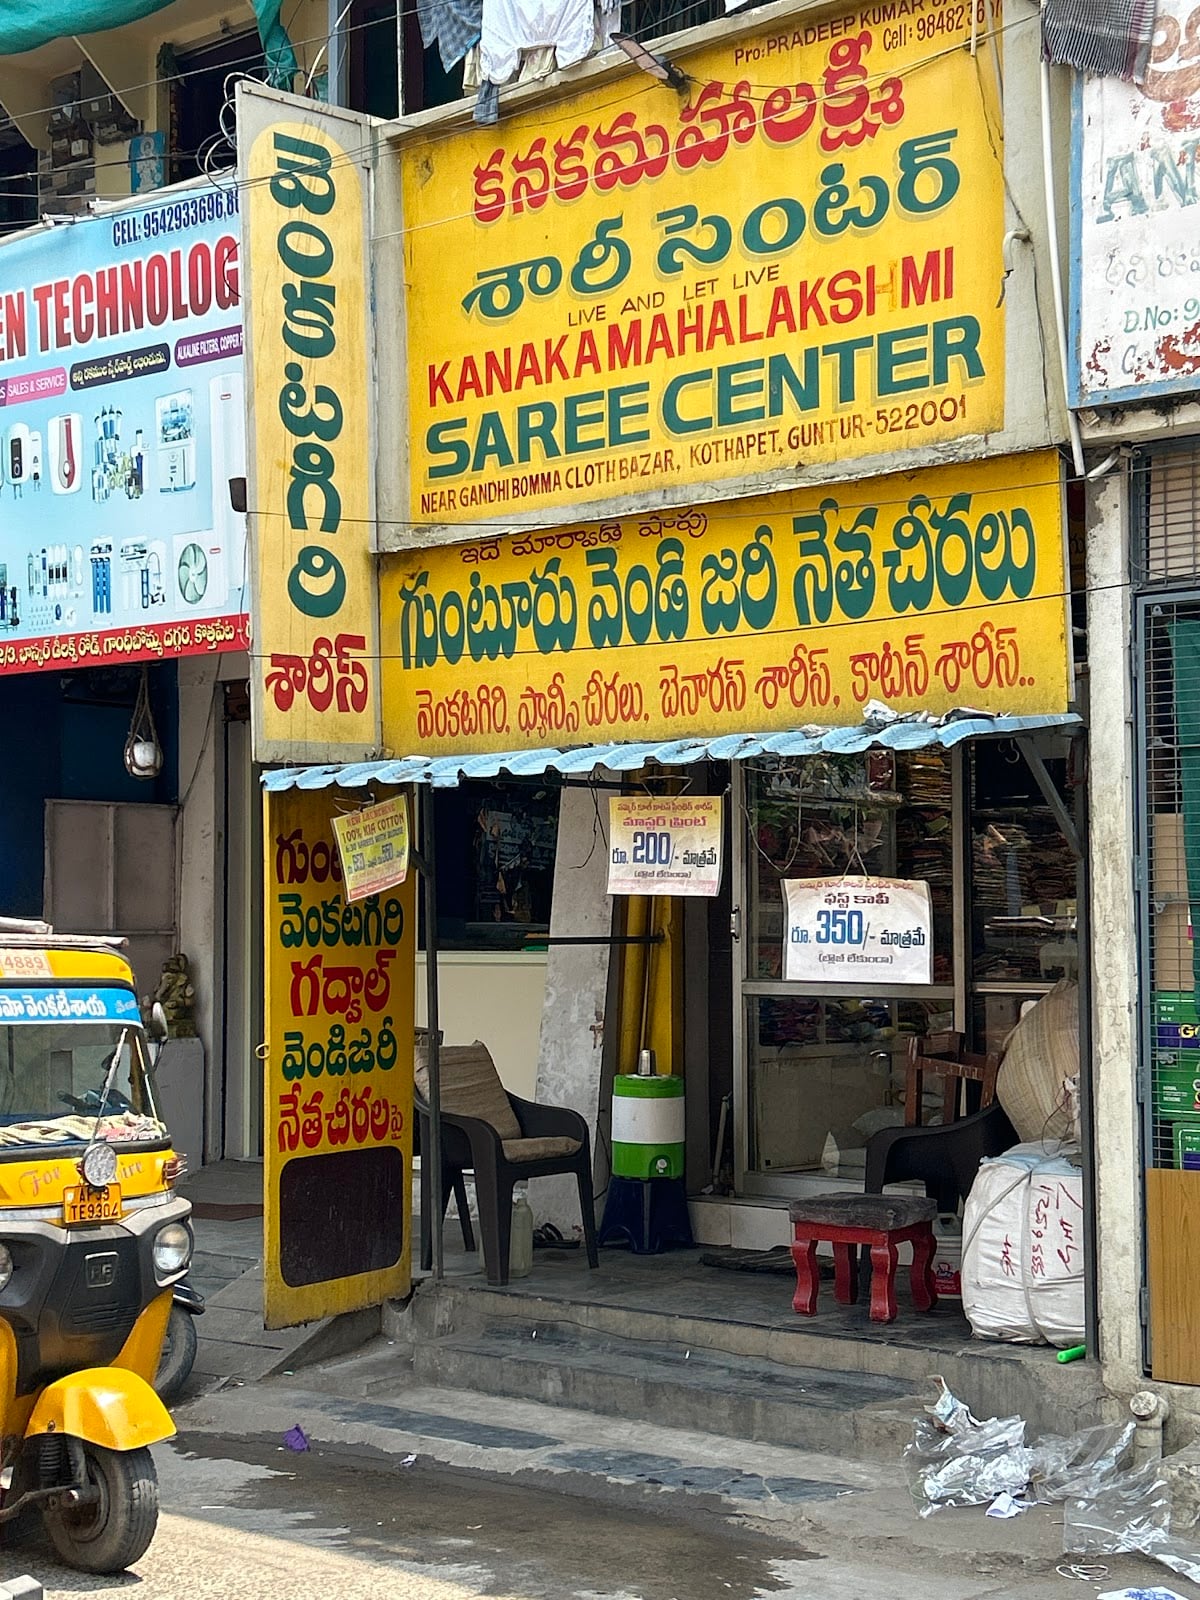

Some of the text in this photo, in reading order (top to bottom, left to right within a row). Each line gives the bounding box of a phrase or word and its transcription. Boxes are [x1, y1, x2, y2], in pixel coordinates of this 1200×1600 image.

[113, 221, 141, 247] CELL:
[461, 129, 960, 318] శారీ సెంటర్
[568, 265, 780, 326] LIVE AND LET LIVE
[8, 381, 29, 397] SALES
[36, 373, 65, 391] SERVICE
[426, 315, 984, 479] SAREE CENTER
[421, 490, 457, 514] NEAR
[460, 481, 510, 507] GANDHI
[512, 471, 562, 499] BOMMA
[566, 460, 616, 489] CLOTH
[620, 449, 681, 480] BAZAR,
[690, 429, 783, 467] KOTHAPET,
[399, 492, 1036, 670] గుంటూరు వెండి జరీ నేత చీరలు
[264, 633, 368, 713] శారీస్
[19, 1161, 145, 1197] For ire
